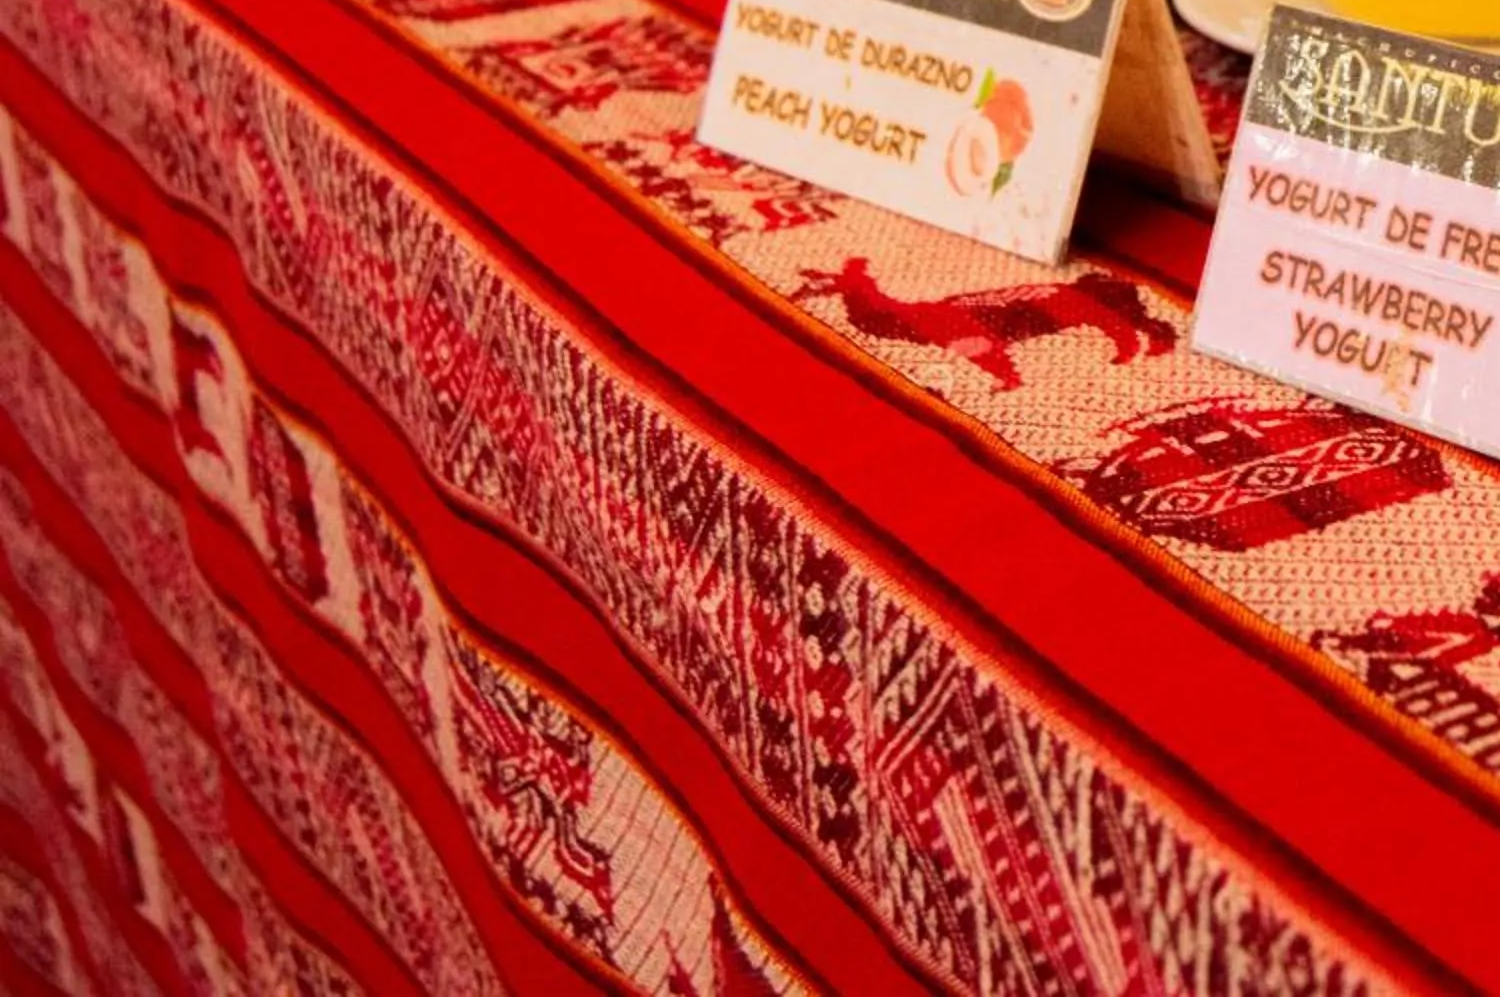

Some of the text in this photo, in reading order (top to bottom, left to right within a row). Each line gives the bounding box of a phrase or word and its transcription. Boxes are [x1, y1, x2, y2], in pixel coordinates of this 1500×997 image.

[736, 3, 974, 94] YOGURT DE DURAZNO
[732, 75, 926, 164] PEACH YOGURT
[1248, 165, 1377, 230] YOGURT
[1385, 204, 1434, 251] DE
[1260, 250, 1495, 349] STRAWBERRY
[1293, 311, 1434, 387] YOGUT
